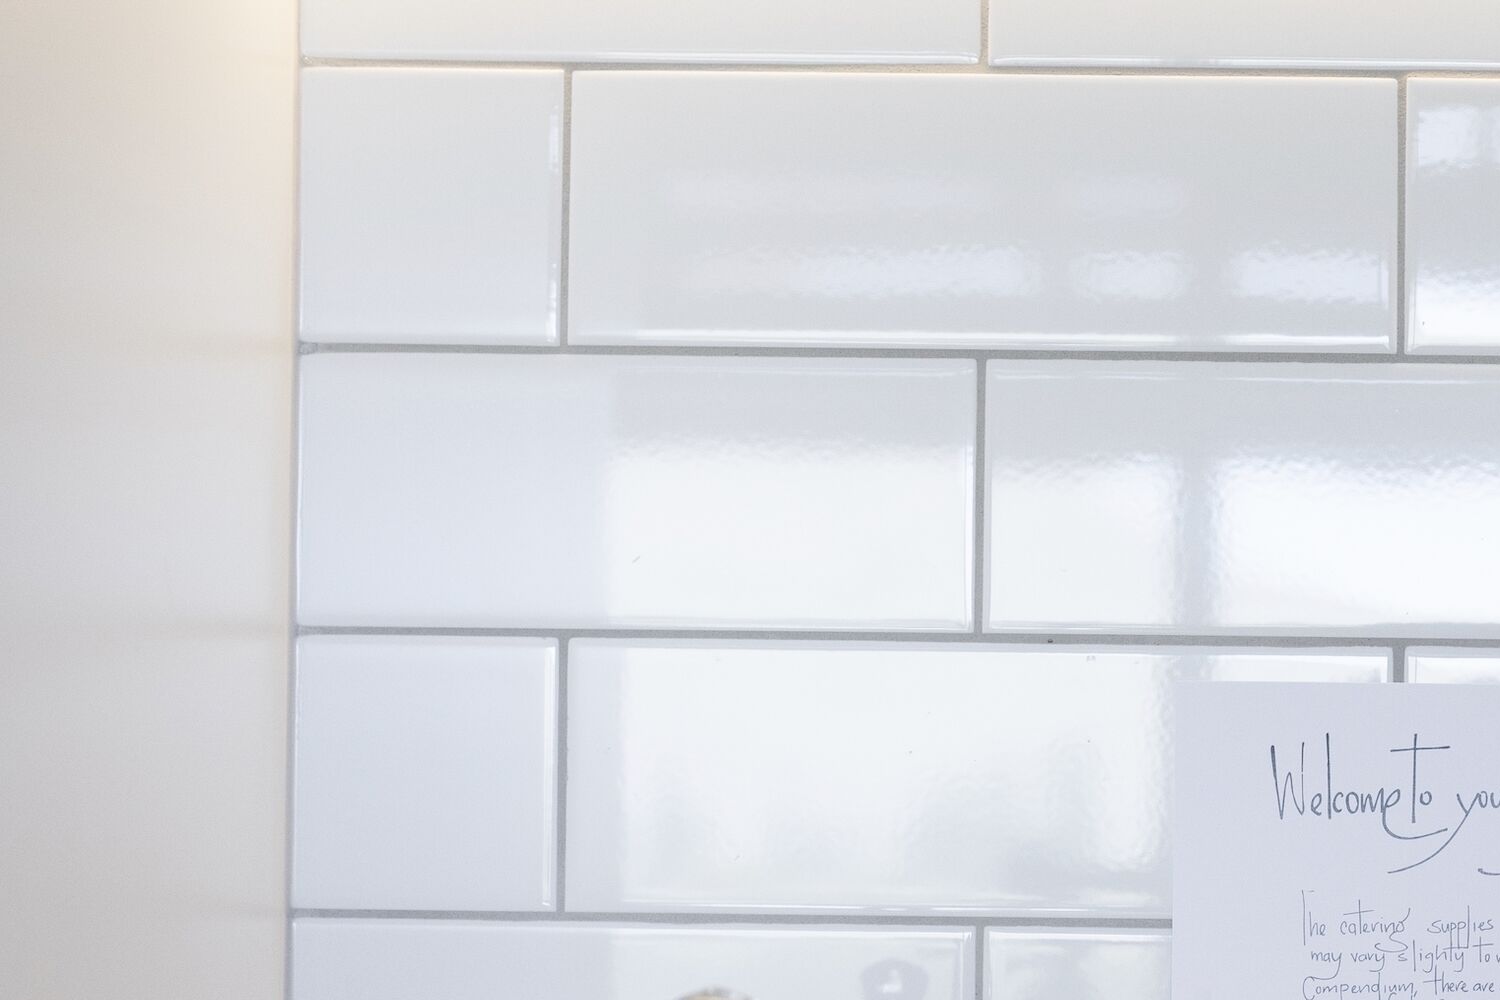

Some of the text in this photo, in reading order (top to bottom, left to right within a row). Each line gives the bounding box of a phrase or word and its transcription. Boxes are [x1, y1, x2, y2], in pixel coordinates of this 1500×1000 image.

[1270, 732, 1448, 840] Welcome
[1301, 889, 1326, 946] The
[1339, 899, 1411, 953] catering
[1426, 905, 1495, 950] supplies
[1310, 950, 1342, 980] may
[1350, 952, 1386, 973] vary
[1472, 935, 1495, 963] to
[1422, 964, 1469, 996] there
[1472, 981, 1496, 993] are
